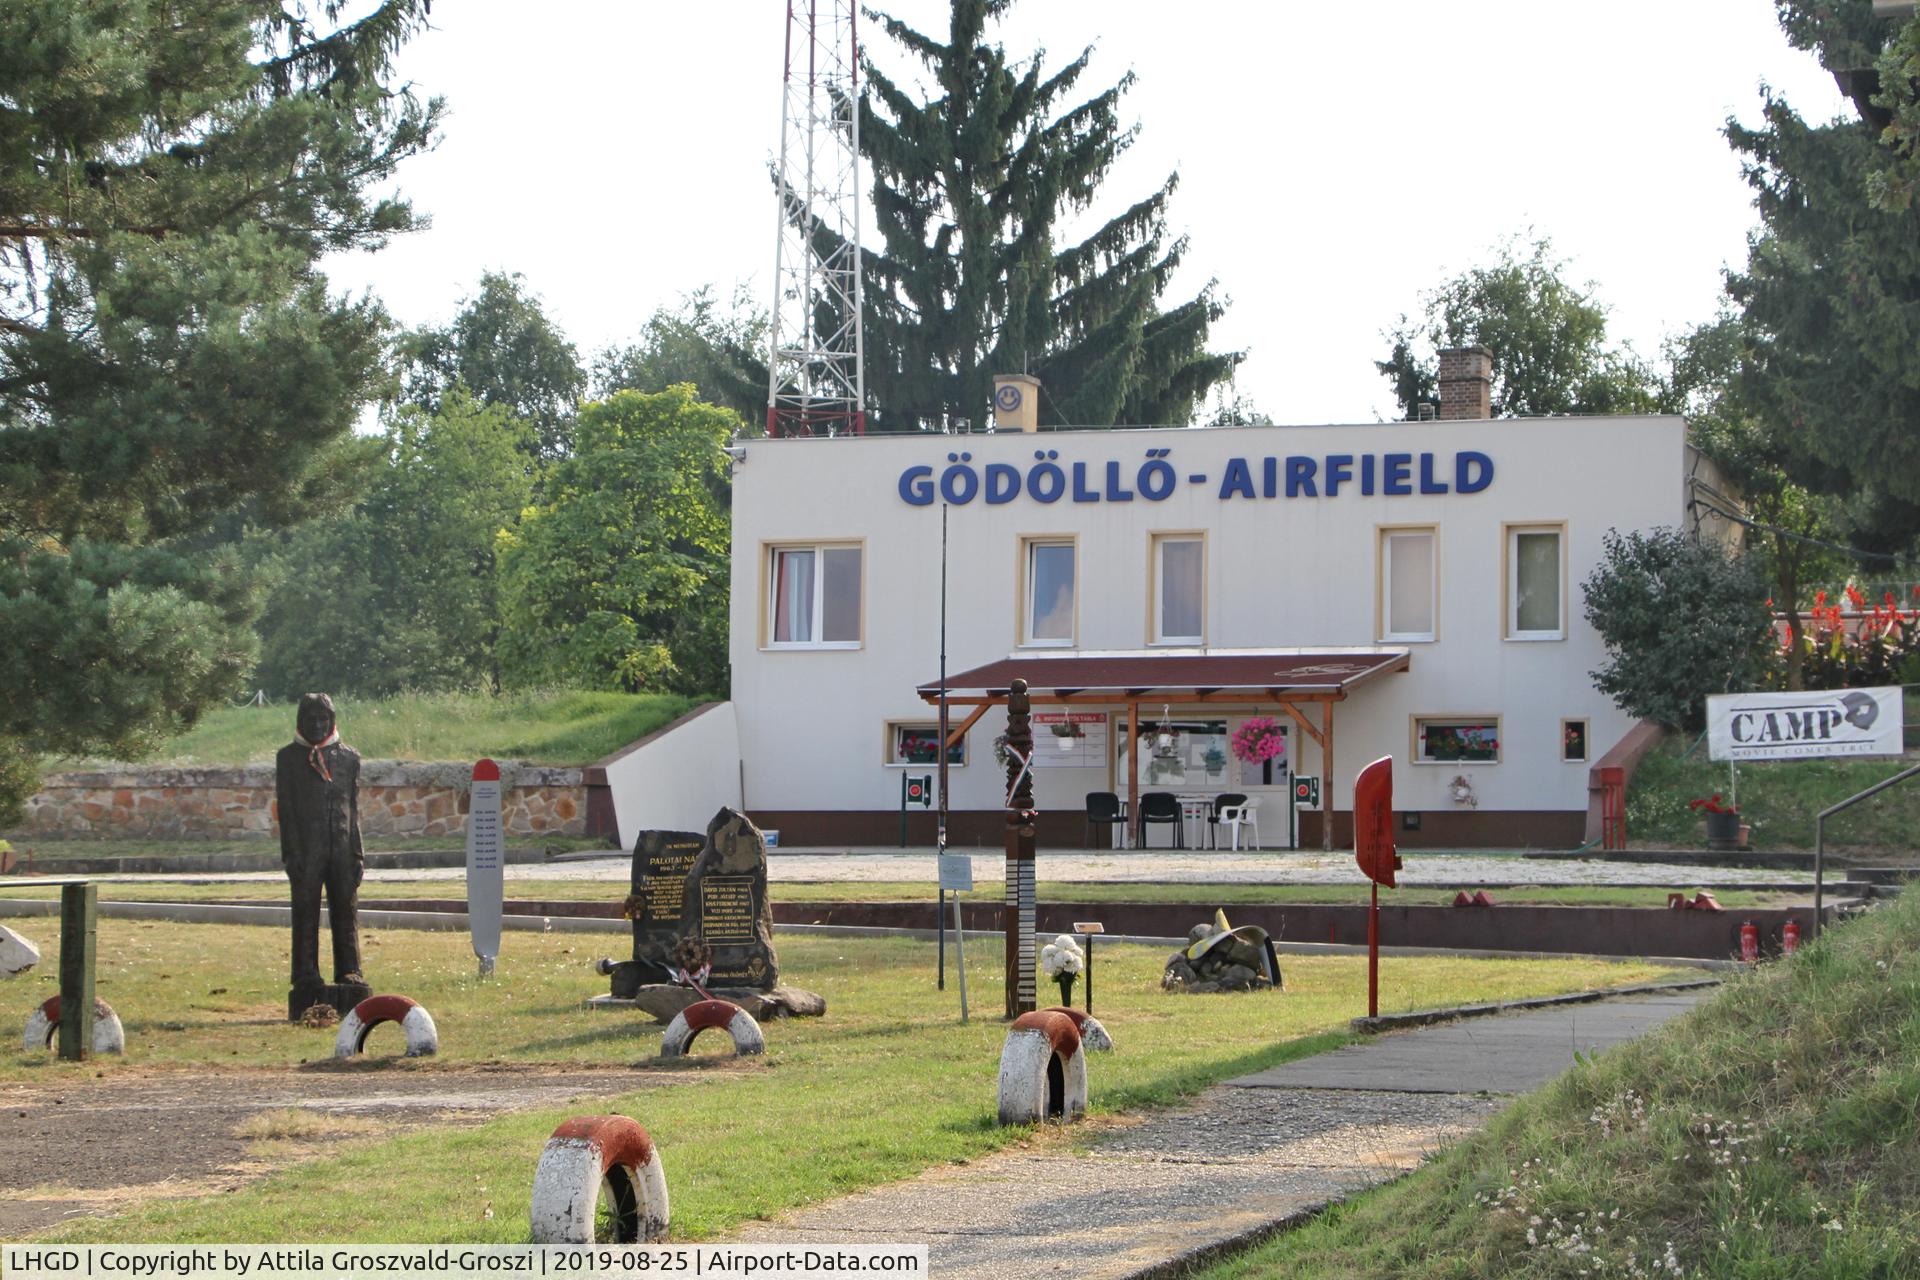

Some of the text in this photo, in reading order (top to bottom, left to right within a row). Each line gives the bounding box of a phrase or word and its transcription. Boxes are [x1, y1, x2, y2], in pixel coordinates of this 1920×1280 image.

[899, 449, 1177, 506] GÖDÖLLŐ
[1219, 451, 1495, 500] AIRFIELD
[1731, 709, 1843, 743] CAMP
[649, 855, 683, 866] PALOTAI
